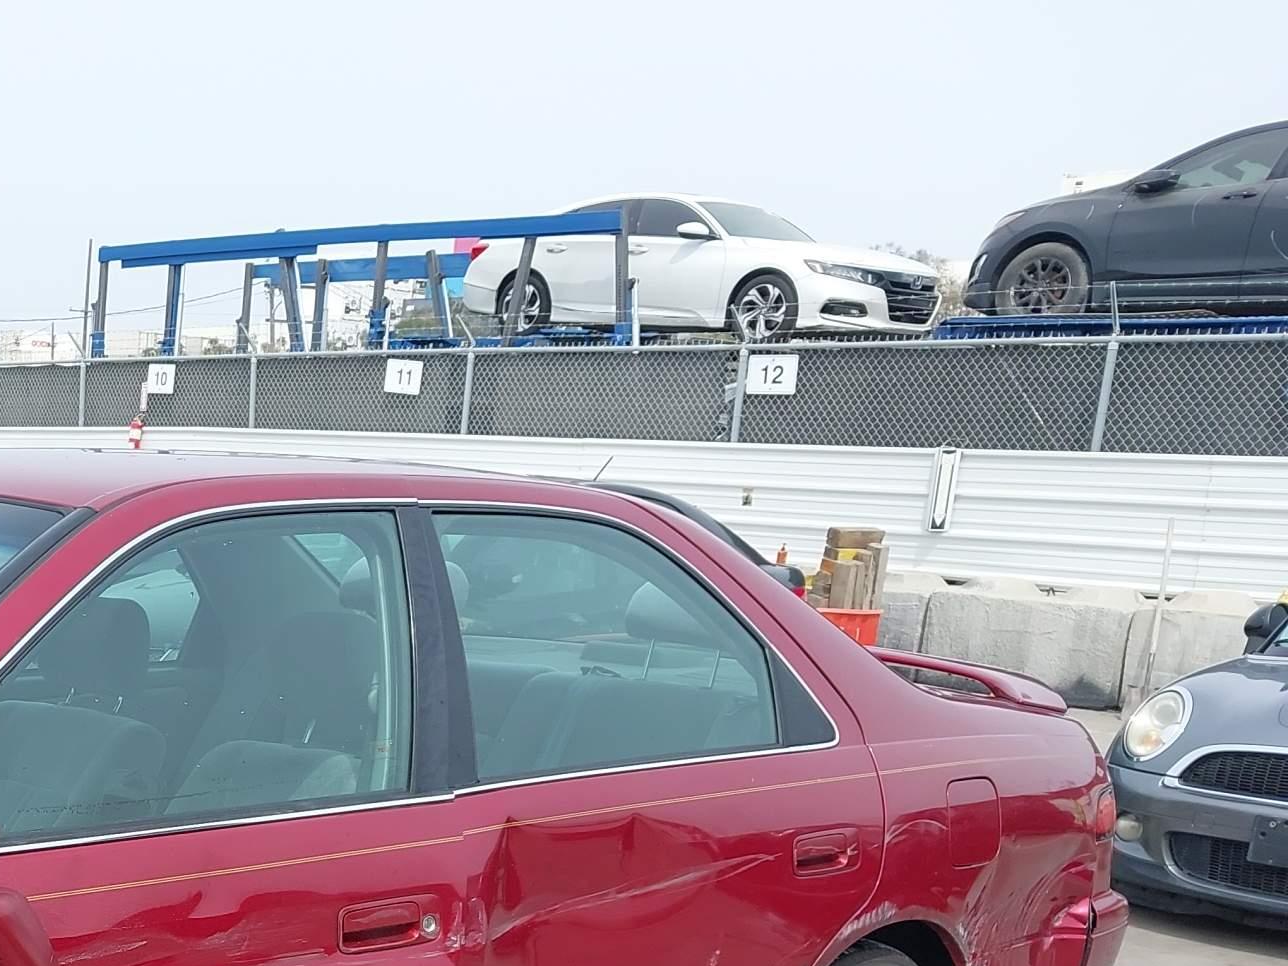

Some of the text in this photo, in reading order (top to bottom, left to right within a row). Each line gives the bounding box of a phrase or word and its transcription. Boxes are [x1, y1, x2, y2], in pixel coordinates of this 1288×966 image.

[155, 371, 167, 386] 10
[397, 368, 412, 385] 11
[761, 364, 784, 385] 12
